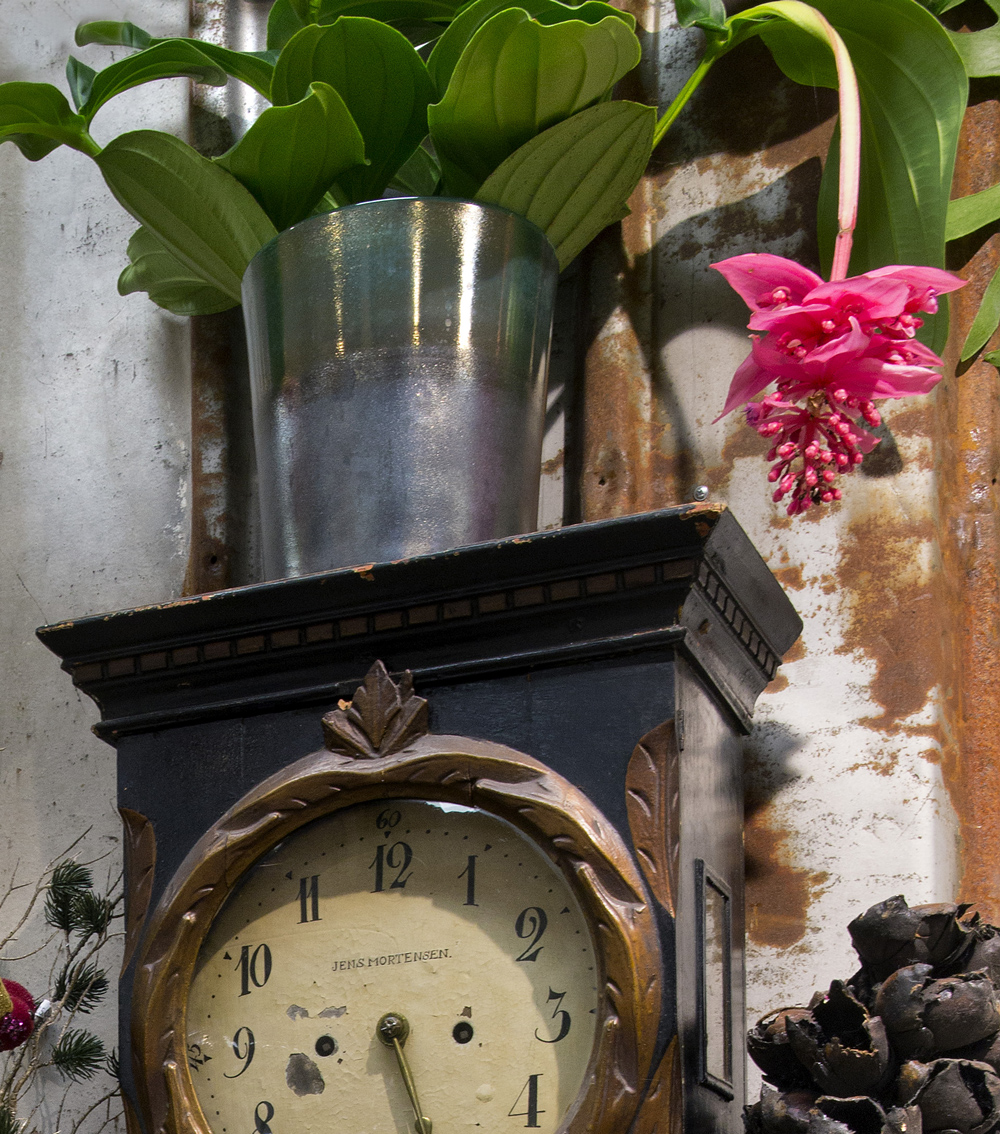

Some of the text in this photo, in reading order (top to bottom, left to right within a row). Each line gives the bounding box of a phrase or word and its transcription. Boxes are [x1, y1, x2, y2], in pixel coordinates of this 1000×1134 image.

[376, 809, 401, 829] 60
[368, 841, 413, 893] 12
[457, 855, 479, 906] 1
[295, 874, 322, 924] 11
[514, 906, 548, 962] 2
[234, 943, 272, 997] 10
[331, 958, 365, 972] JENS
[534, 985, 571, 1043] 3
[223, 1026, 255, 1078] 9
[507, 1073, 546, 1128] 4
